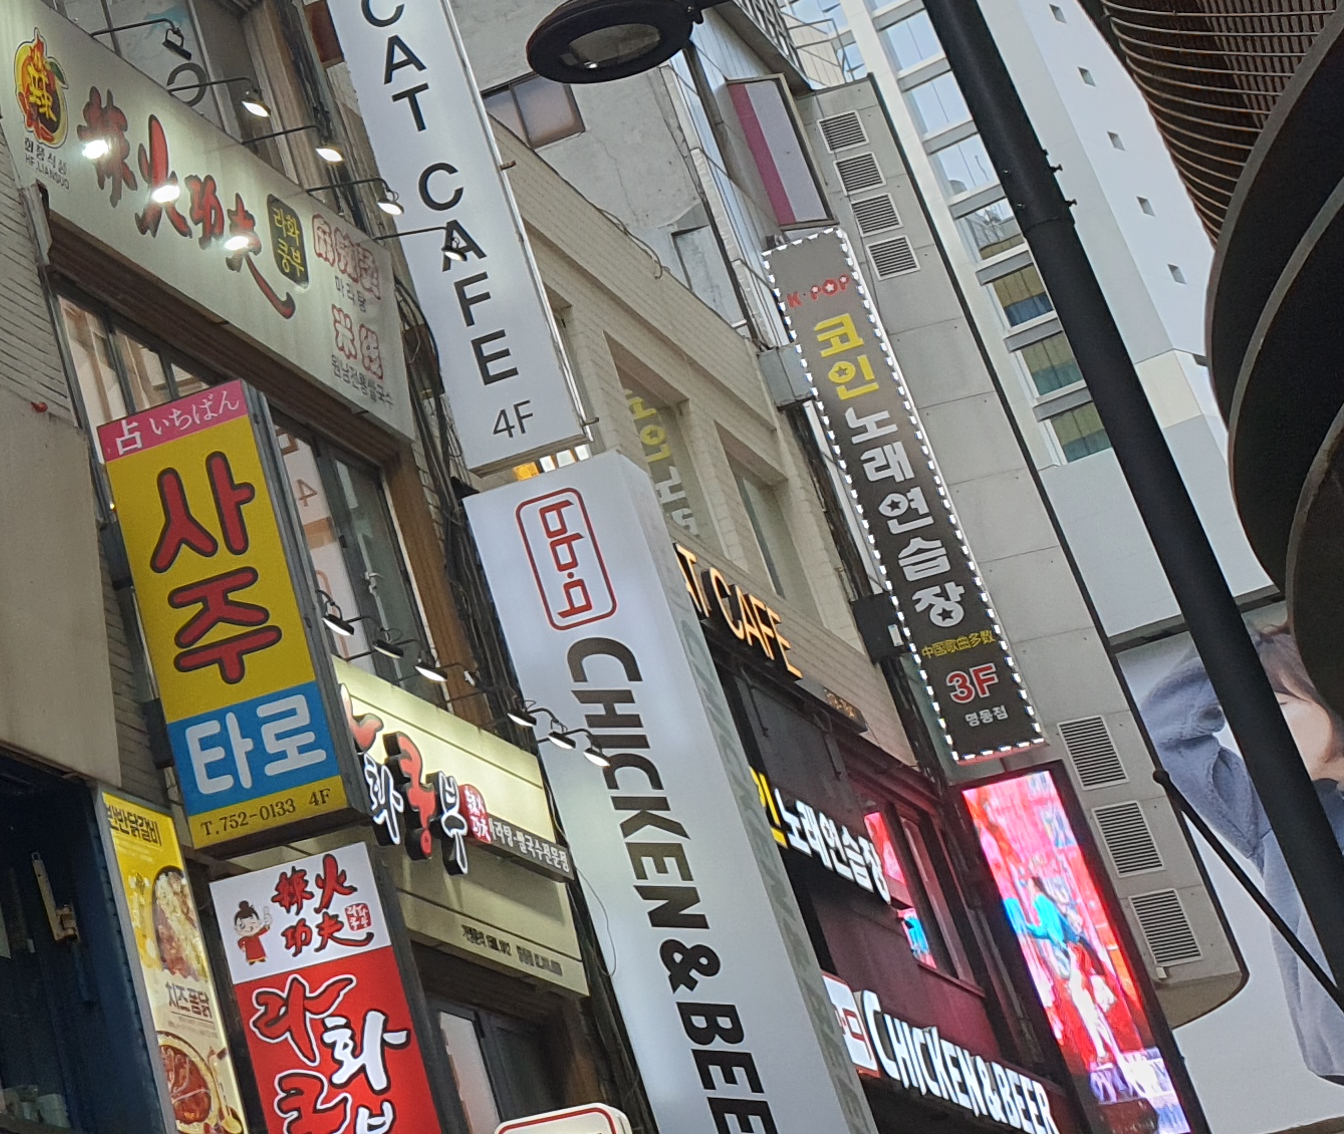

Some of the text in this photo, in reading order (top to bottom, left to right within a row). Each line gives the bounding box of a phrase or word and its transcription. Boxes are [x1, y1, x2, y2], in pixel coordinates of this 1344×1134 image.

[417, 161, 520, 387] CAFE
[115, 389, 241, 456] 占 いちばん
[492, 399, 536, 440] 4F
[814, 312, 966, 628] 코인 노래연습장
[149, 450, 283, 685] 사주
[709, 566, 804, 679] CAFE
[945, 662, 999, 704] 3F
[965, 704, 1009, 728] 명동점
[185, 693, 328, 795] 타로
[200, 787, 333, 838] T.752-0133 4F
[565, 635, 711, 930] CHICKEN
[658, 937, 722, 994] &
[773, 787, 891, 906] 노래연습장
